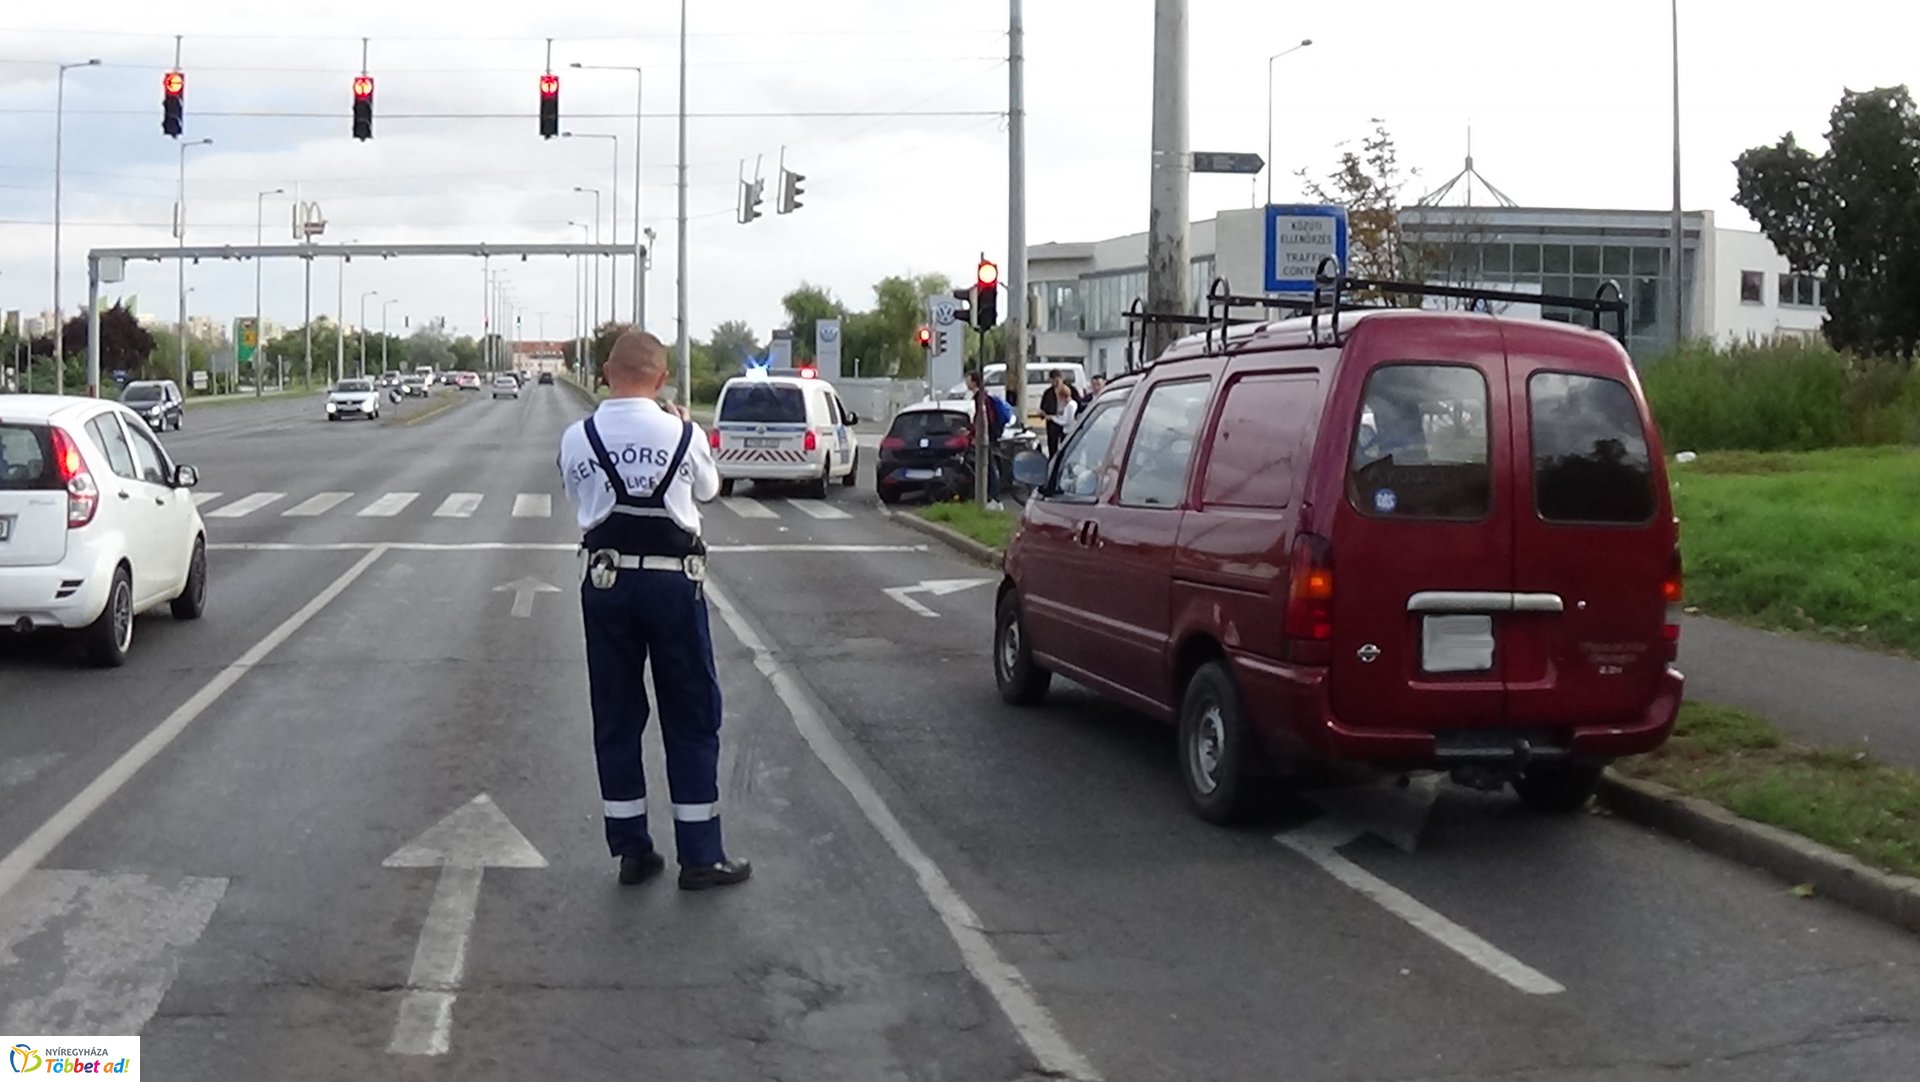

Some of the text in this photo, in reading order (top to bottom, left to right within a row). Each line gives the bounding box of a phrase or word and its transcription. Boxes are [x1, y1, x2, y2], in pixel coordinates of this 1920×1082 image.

[1291, 220, 1323, 231] KÖZÚTI
[1280, 232, 1332, 245] ELLENŐRZÉS
[1283, 266, 1318, 277] CONTR
[572, 443, 690, 486] ENDŐRSG
[604, 475, 657, 493] PLICE
